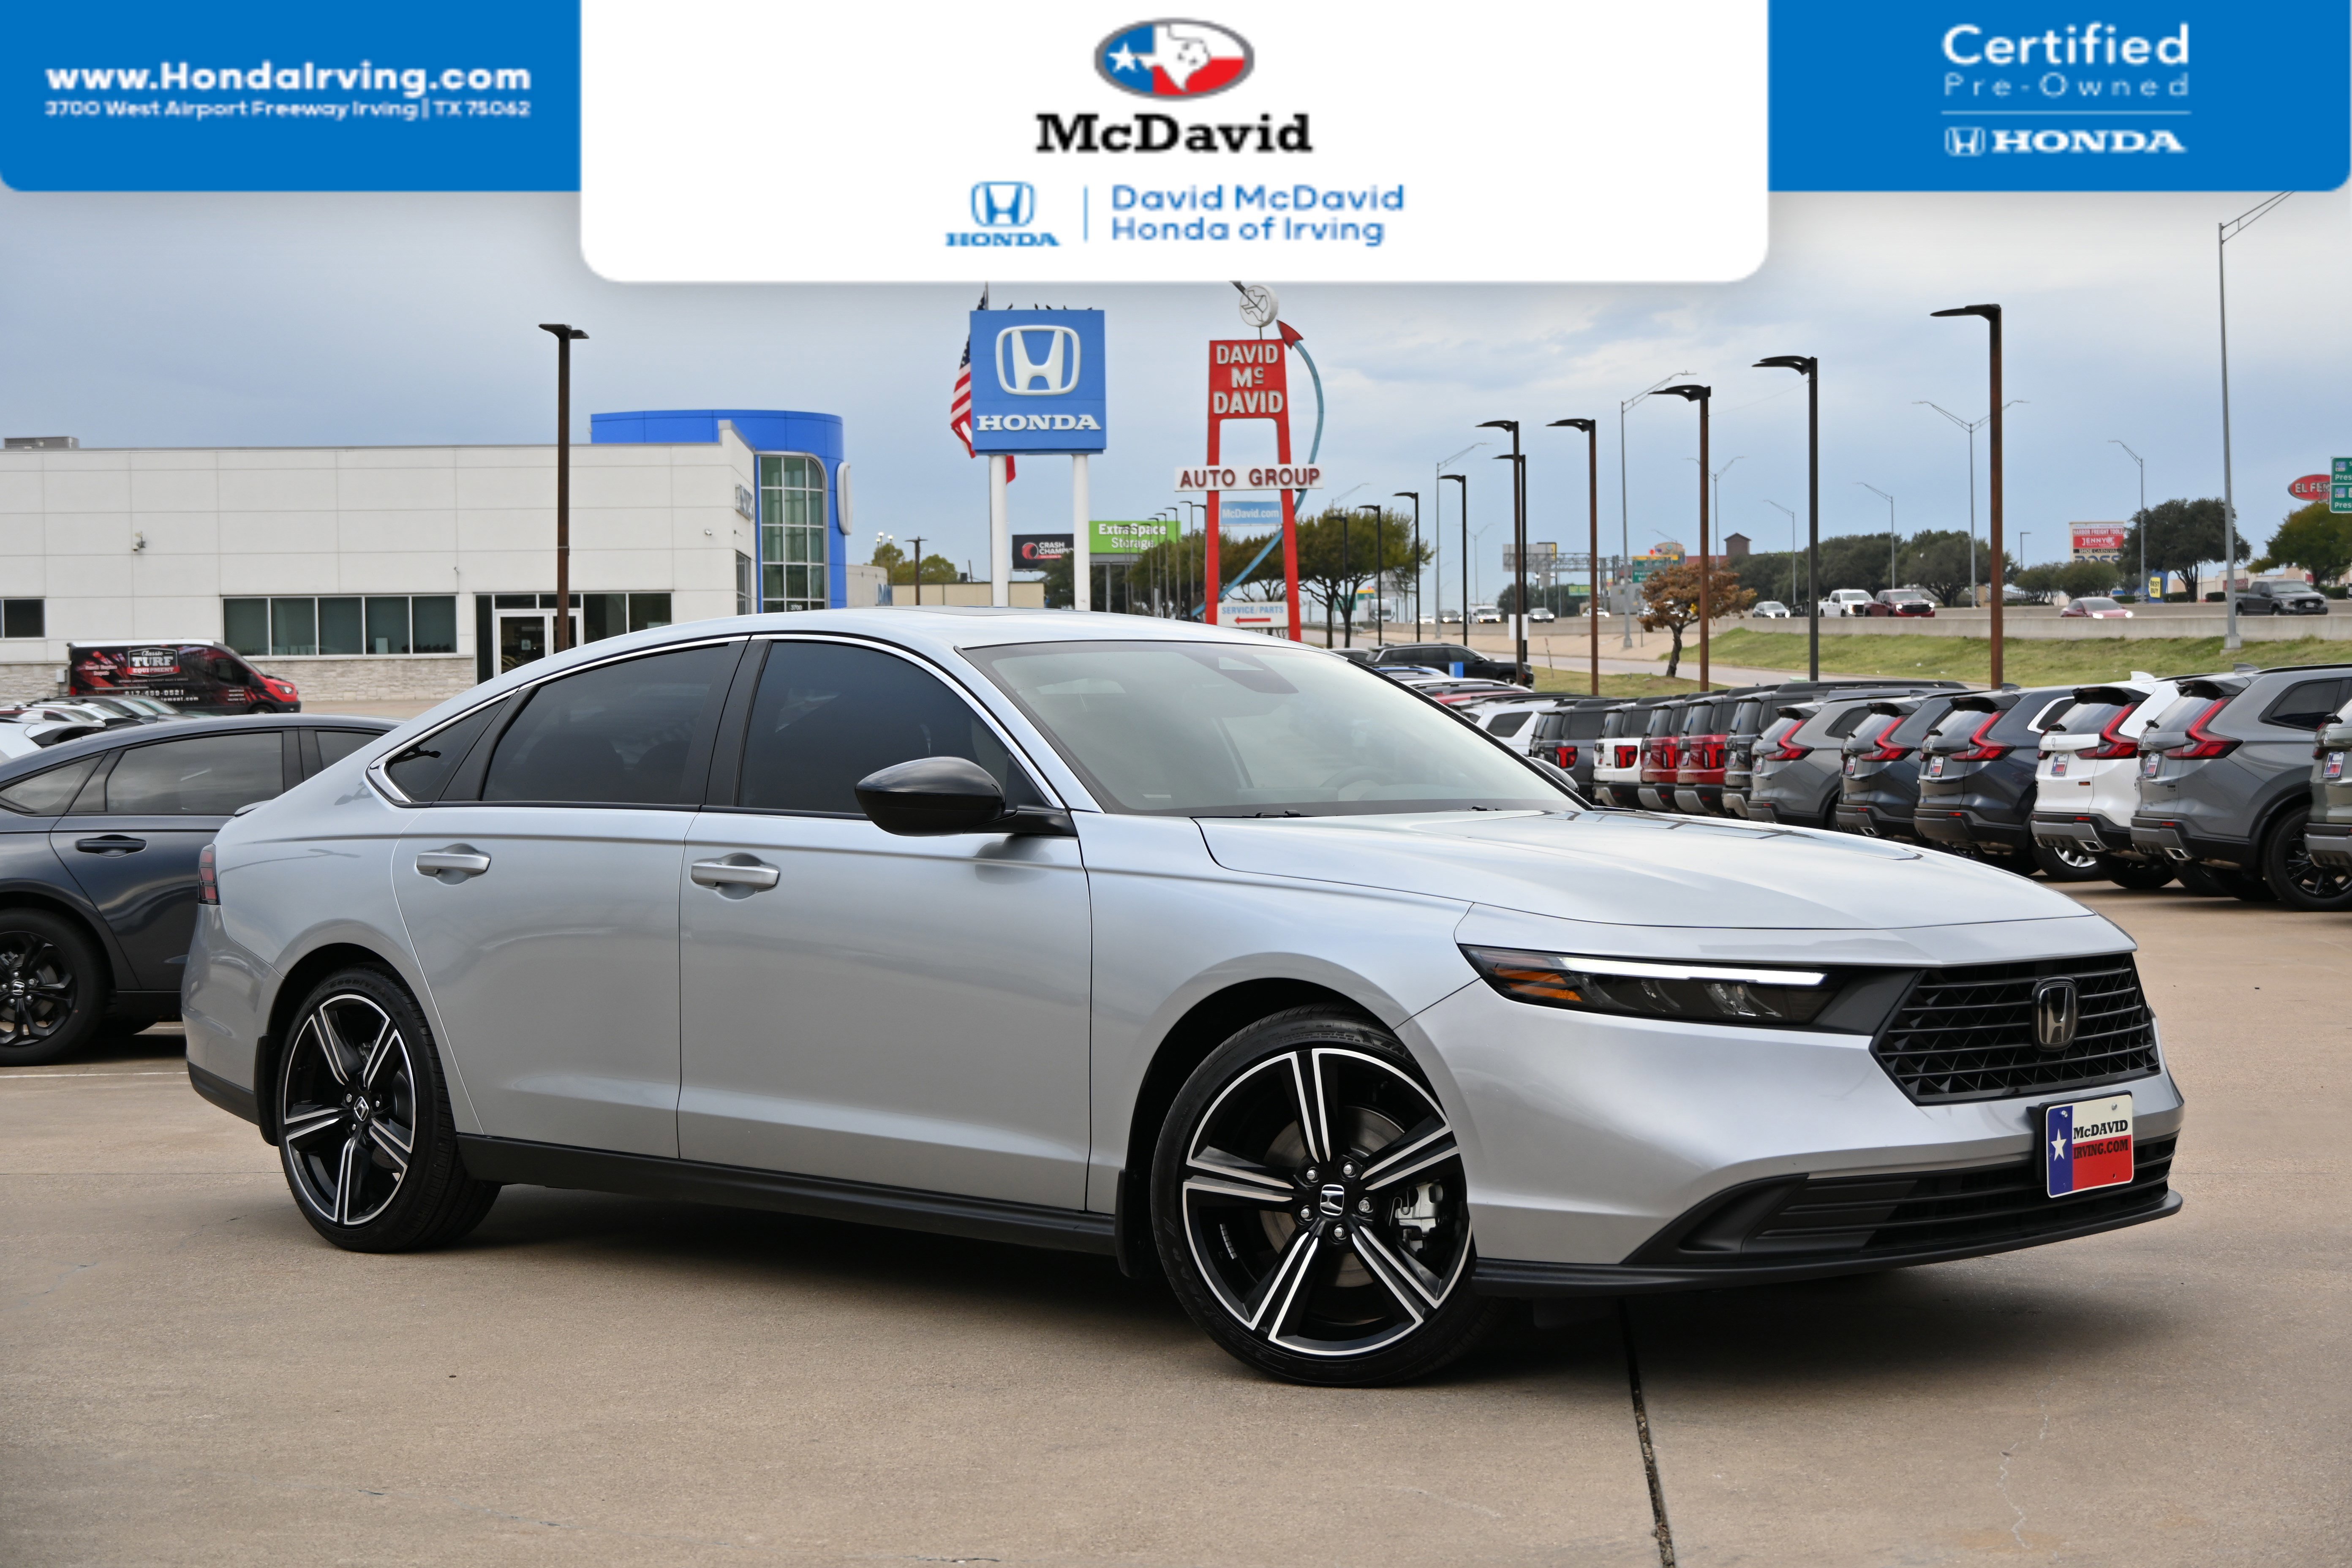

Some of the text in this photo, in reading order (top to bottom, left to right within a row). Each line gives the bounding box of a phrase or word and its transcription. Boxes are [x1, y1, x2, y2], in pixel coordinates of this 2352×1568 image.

[1216, 344, 1278, 364] DAVID
[1213, 390, 1283, 414] DAVID
[977, 414, 1101, 431] HONDA
[1180, 468, 1320, 488] AUTO GROUP
[2295, 483, 2307, 493] EL
[1222, 509, 1279, 518] McDavid.com
[1111, 537, 1154, 550] Storage
[132, 656, 173, 667] TURF
[2073, 1120, 2128, 1139] McDAVID
[2074, 1139, 2128, 1160] IRVING.COM
